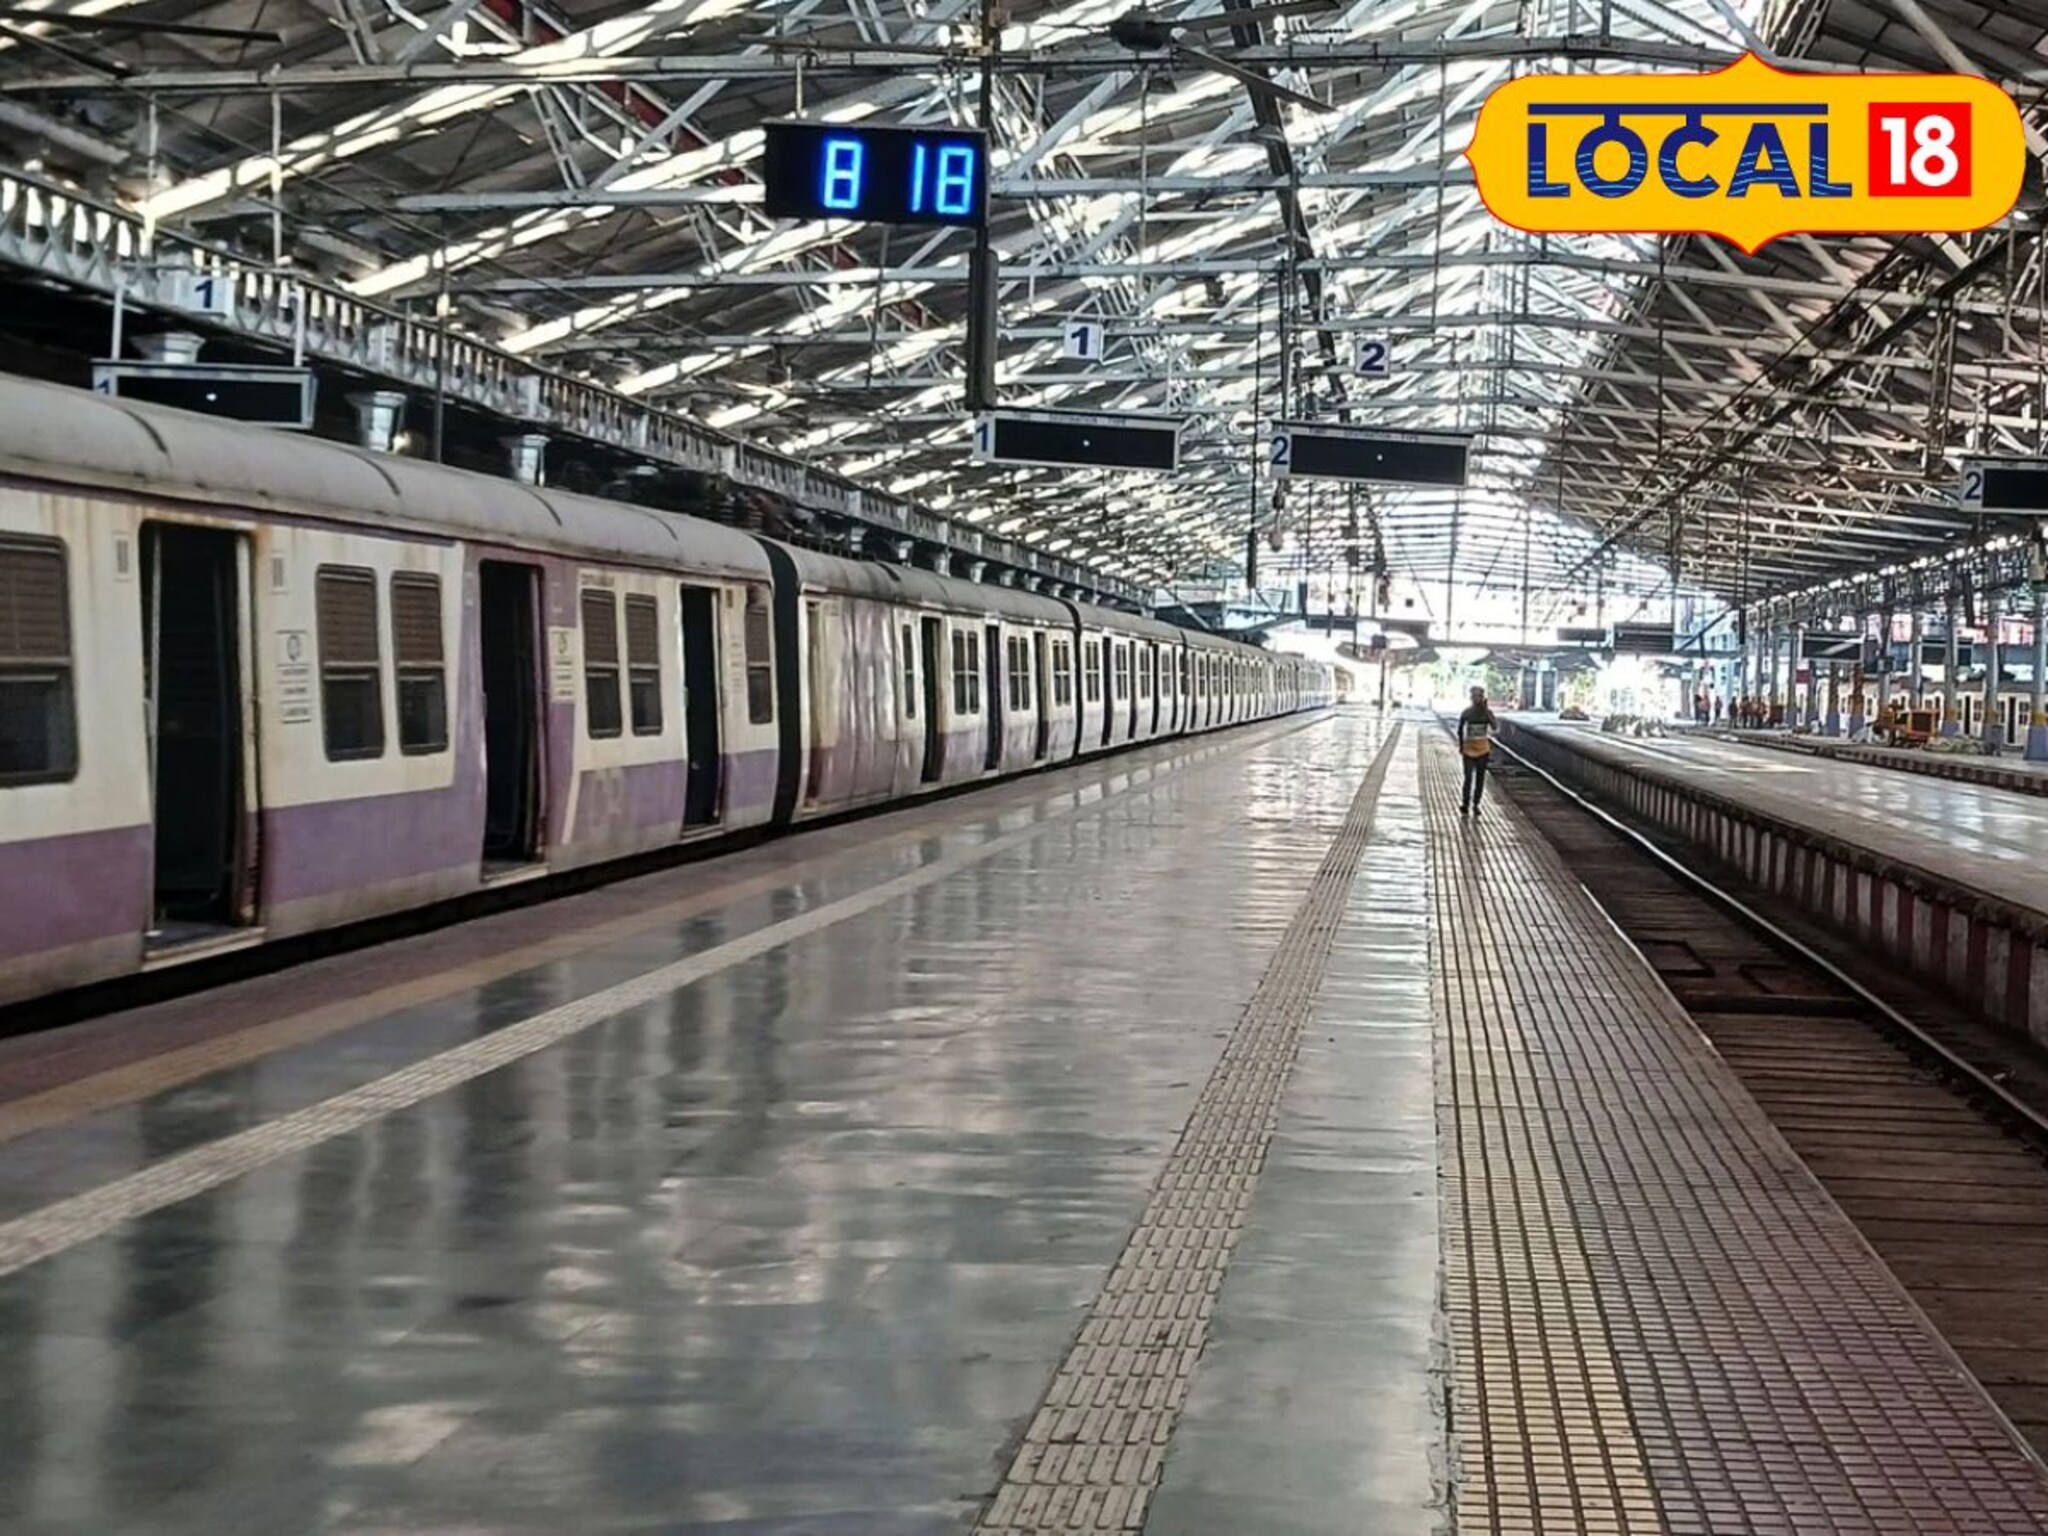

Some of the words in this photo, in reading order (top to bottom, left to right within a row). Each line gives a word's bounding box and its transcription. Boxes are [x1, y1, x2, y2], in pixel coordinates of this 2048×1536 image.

[823, 140, 863, 209] 8
[911, 144, 974, 214] 18
[195, 280, 213, 308] 1
[1071, 326, 1088, 355] 1
[1361, 343, 1385, 371] 2
[975, 422, 988, 452] 1
[1271, 436, 1288, 465] 2
[1965, 471, 1981, 500] 2
